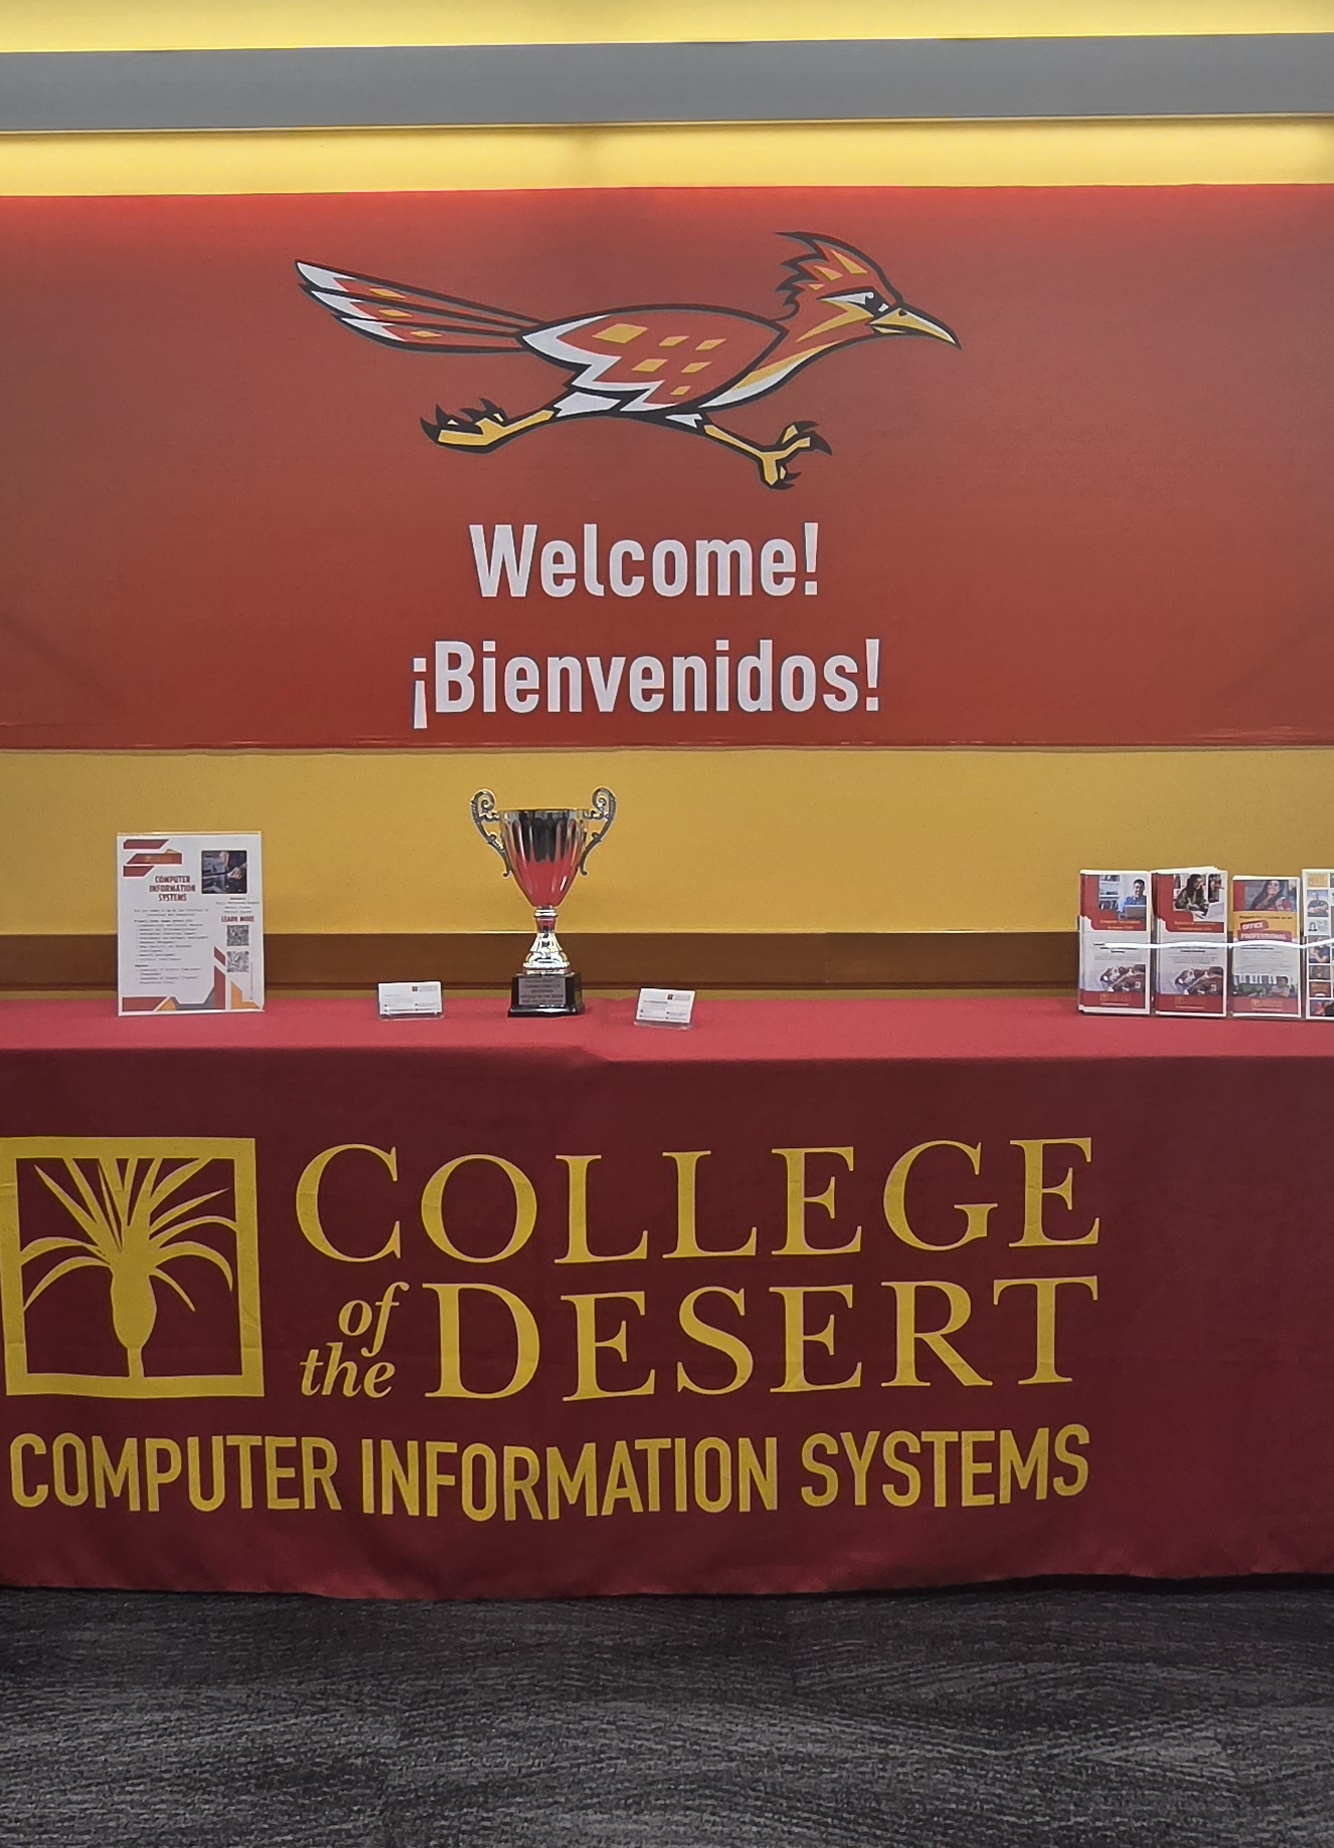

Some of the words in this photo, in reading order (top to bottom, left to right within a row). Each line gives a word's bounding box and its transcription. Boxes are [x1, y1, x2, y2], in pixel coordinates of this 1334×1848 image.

[469, 521, 819, 598] Welcome!
[412, 638, 881, 730] ¡Bienvenidos!
[149, 884, 196, 893] INFORMATION
[155, 875, 191, 884] COMPUTER
[158, 893, 187, 902] SYSTEMS
[294, 1136, 1100, 1265] COLLEGE
[299, 1342, 396, 1398] the
[421, 1274, 1099, 1401] DESERT
[338, 1281, 410, 1358] of
[10, 1432, 342, 1512] COMPUTER
[361, 1435, 779, 1522] INFORMATION
[800, 1423, 1090, 1509] SYSTEMS
